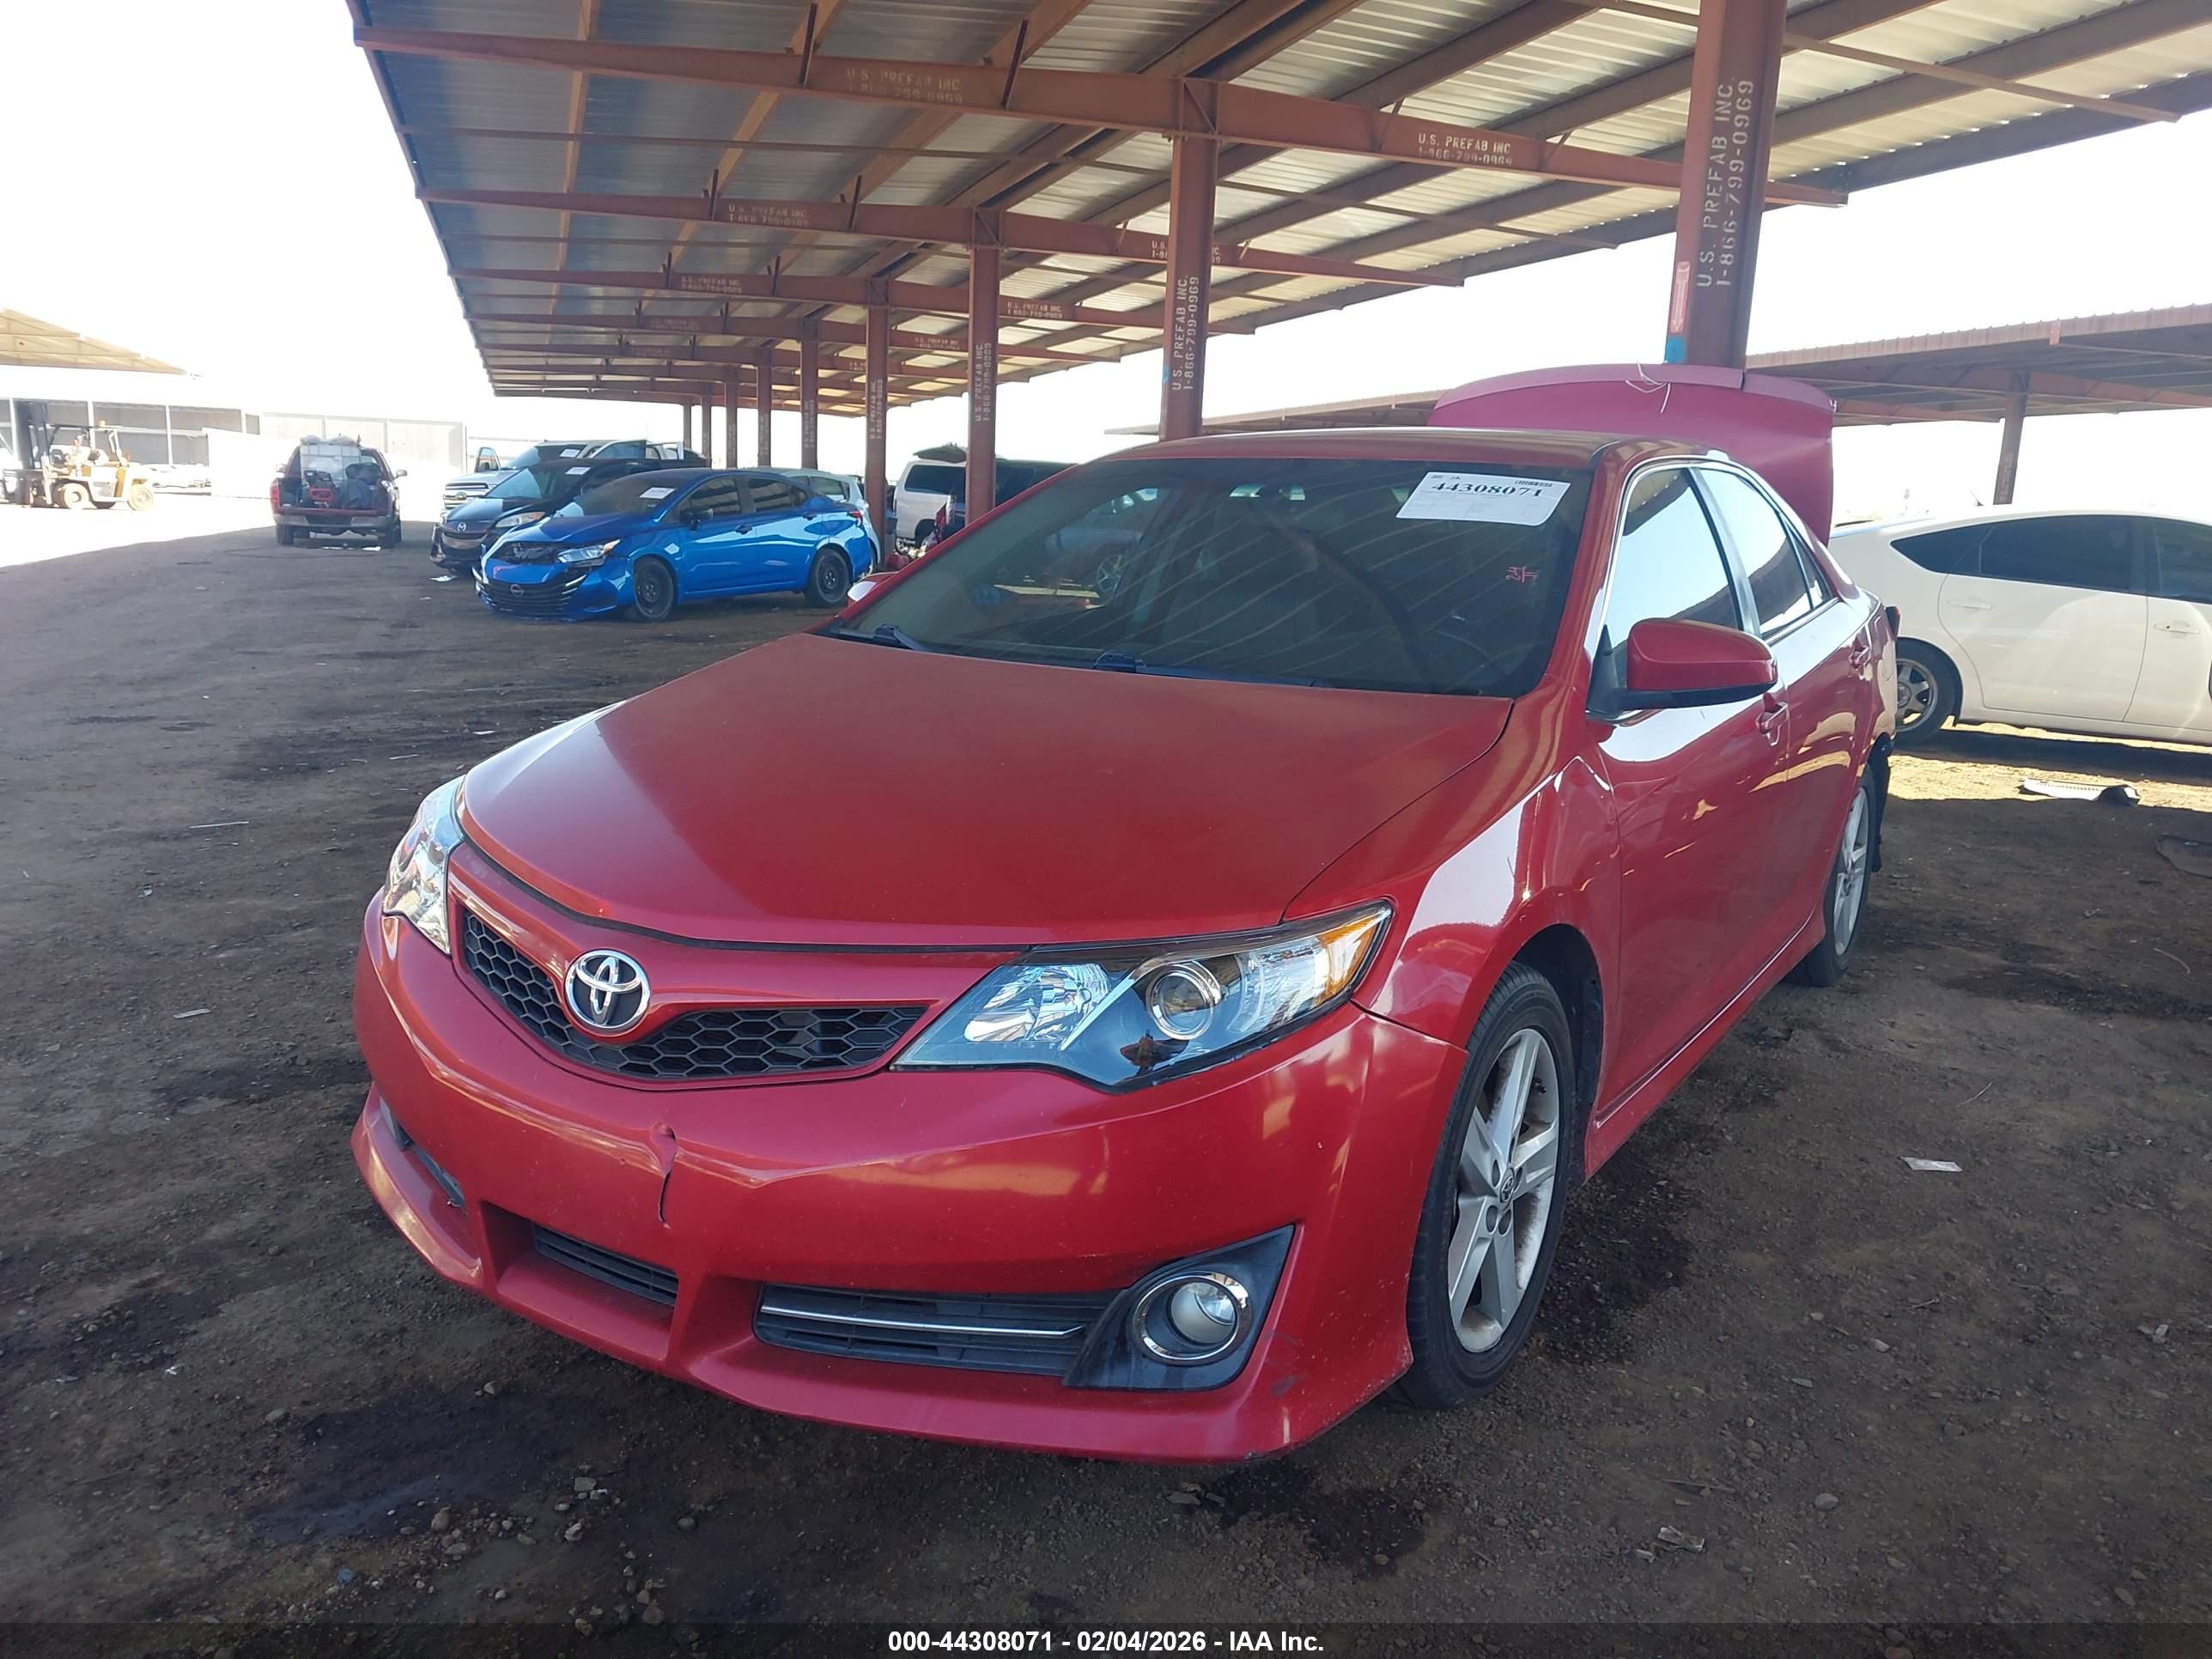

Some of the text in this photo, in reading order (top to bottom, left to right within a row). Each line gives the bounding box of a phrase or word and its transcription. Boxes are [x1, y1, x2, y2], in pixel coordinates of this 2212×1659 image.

[1418, 132, 1440, 146] U.S.
[1445, 136, 1489, 152] PREFAB
[1702, 136, 1728, 229] PREFAB
[1716, 80, 1754, 286] 1-866-799-0969
[1697, 244, 1717, 287] U.S.
[1173, 307, 1186, 358] PREFAB
[1182, 276, 1200, 390] 1-866-799-0969
[1171, 366, 1183, 391] U.S.
[1431, 482, 1543, 497] 44308071
